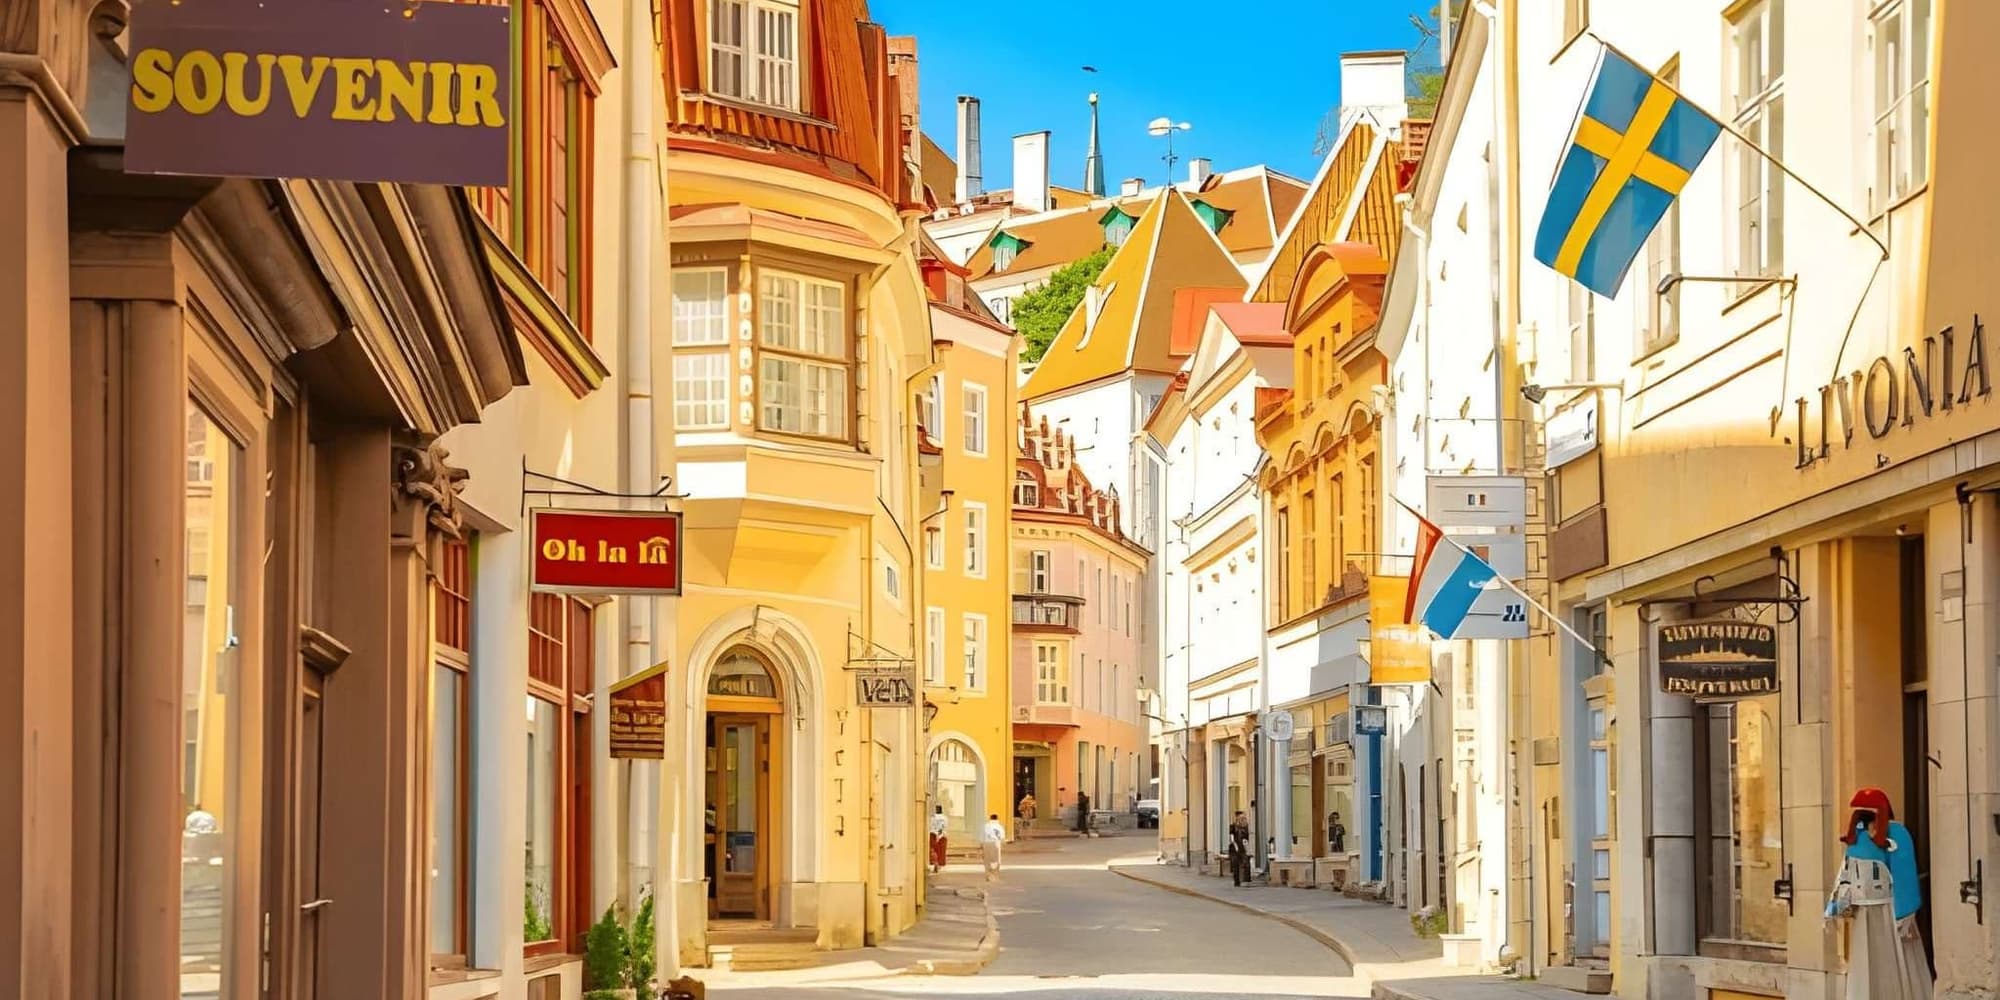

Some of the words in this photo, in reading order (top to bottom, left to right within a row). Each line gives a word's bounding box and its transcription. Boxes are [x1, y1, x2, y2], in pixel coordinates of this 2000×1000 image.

[132, 49, 506, 127] SOUVENIR
[1795, 313, 1992, 470] LIVONIA
[543, 538, 586, 562] Oh
